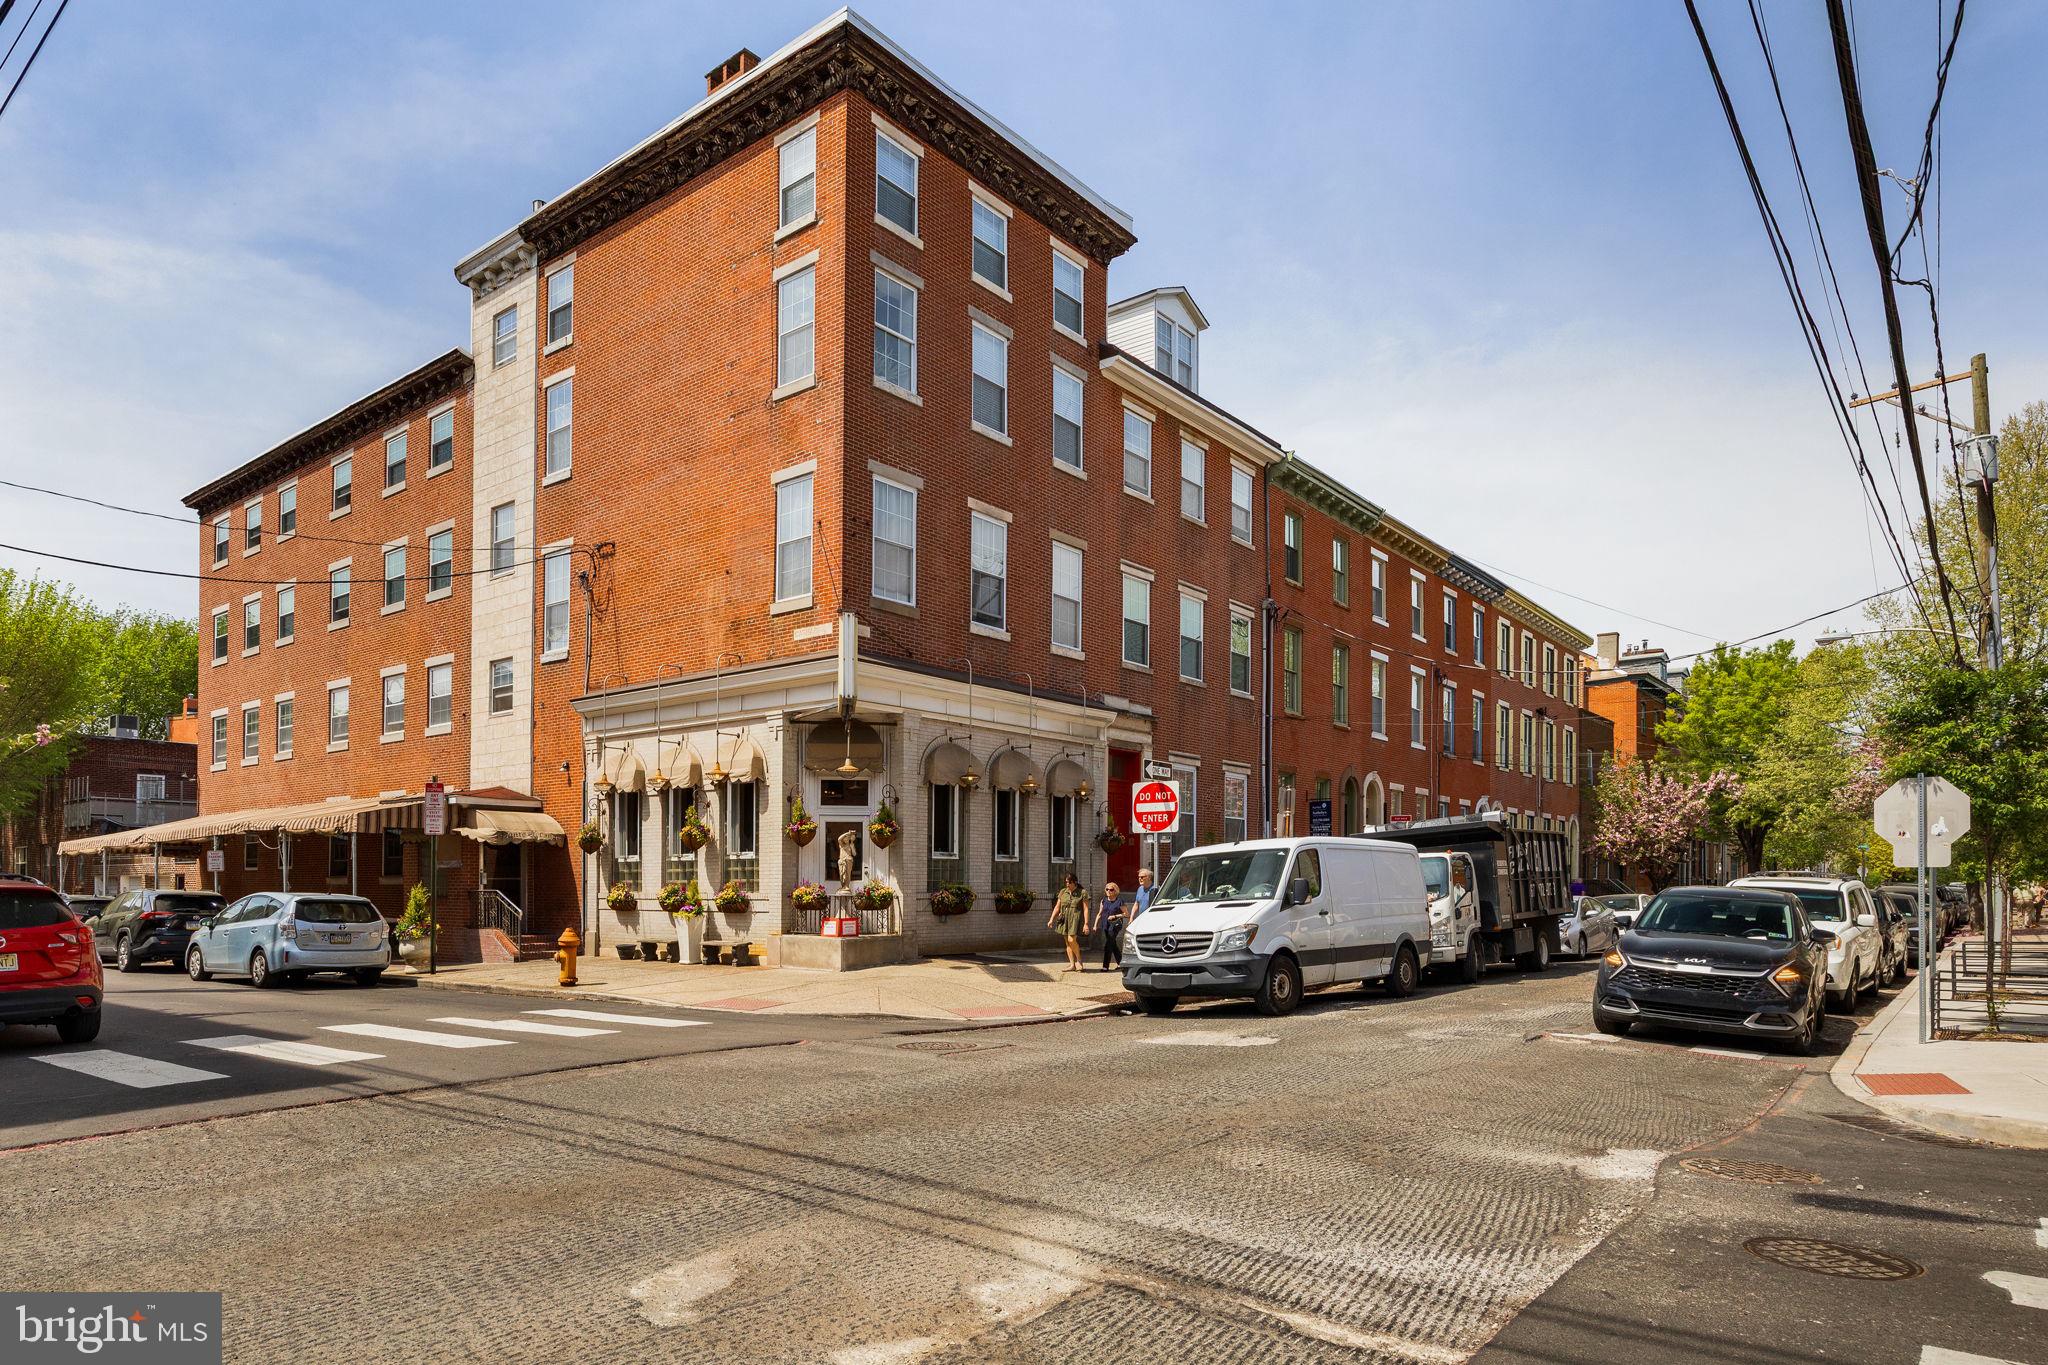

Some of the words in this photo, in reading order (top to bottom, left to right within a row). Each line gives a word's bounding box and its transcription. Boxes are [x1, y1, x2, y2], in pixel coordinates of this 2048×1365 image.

[1139, 792, 1151, 801] DO
[1155, 791, 1172, 800] NOT
[1142, 813, 1168, 823] ENTER
